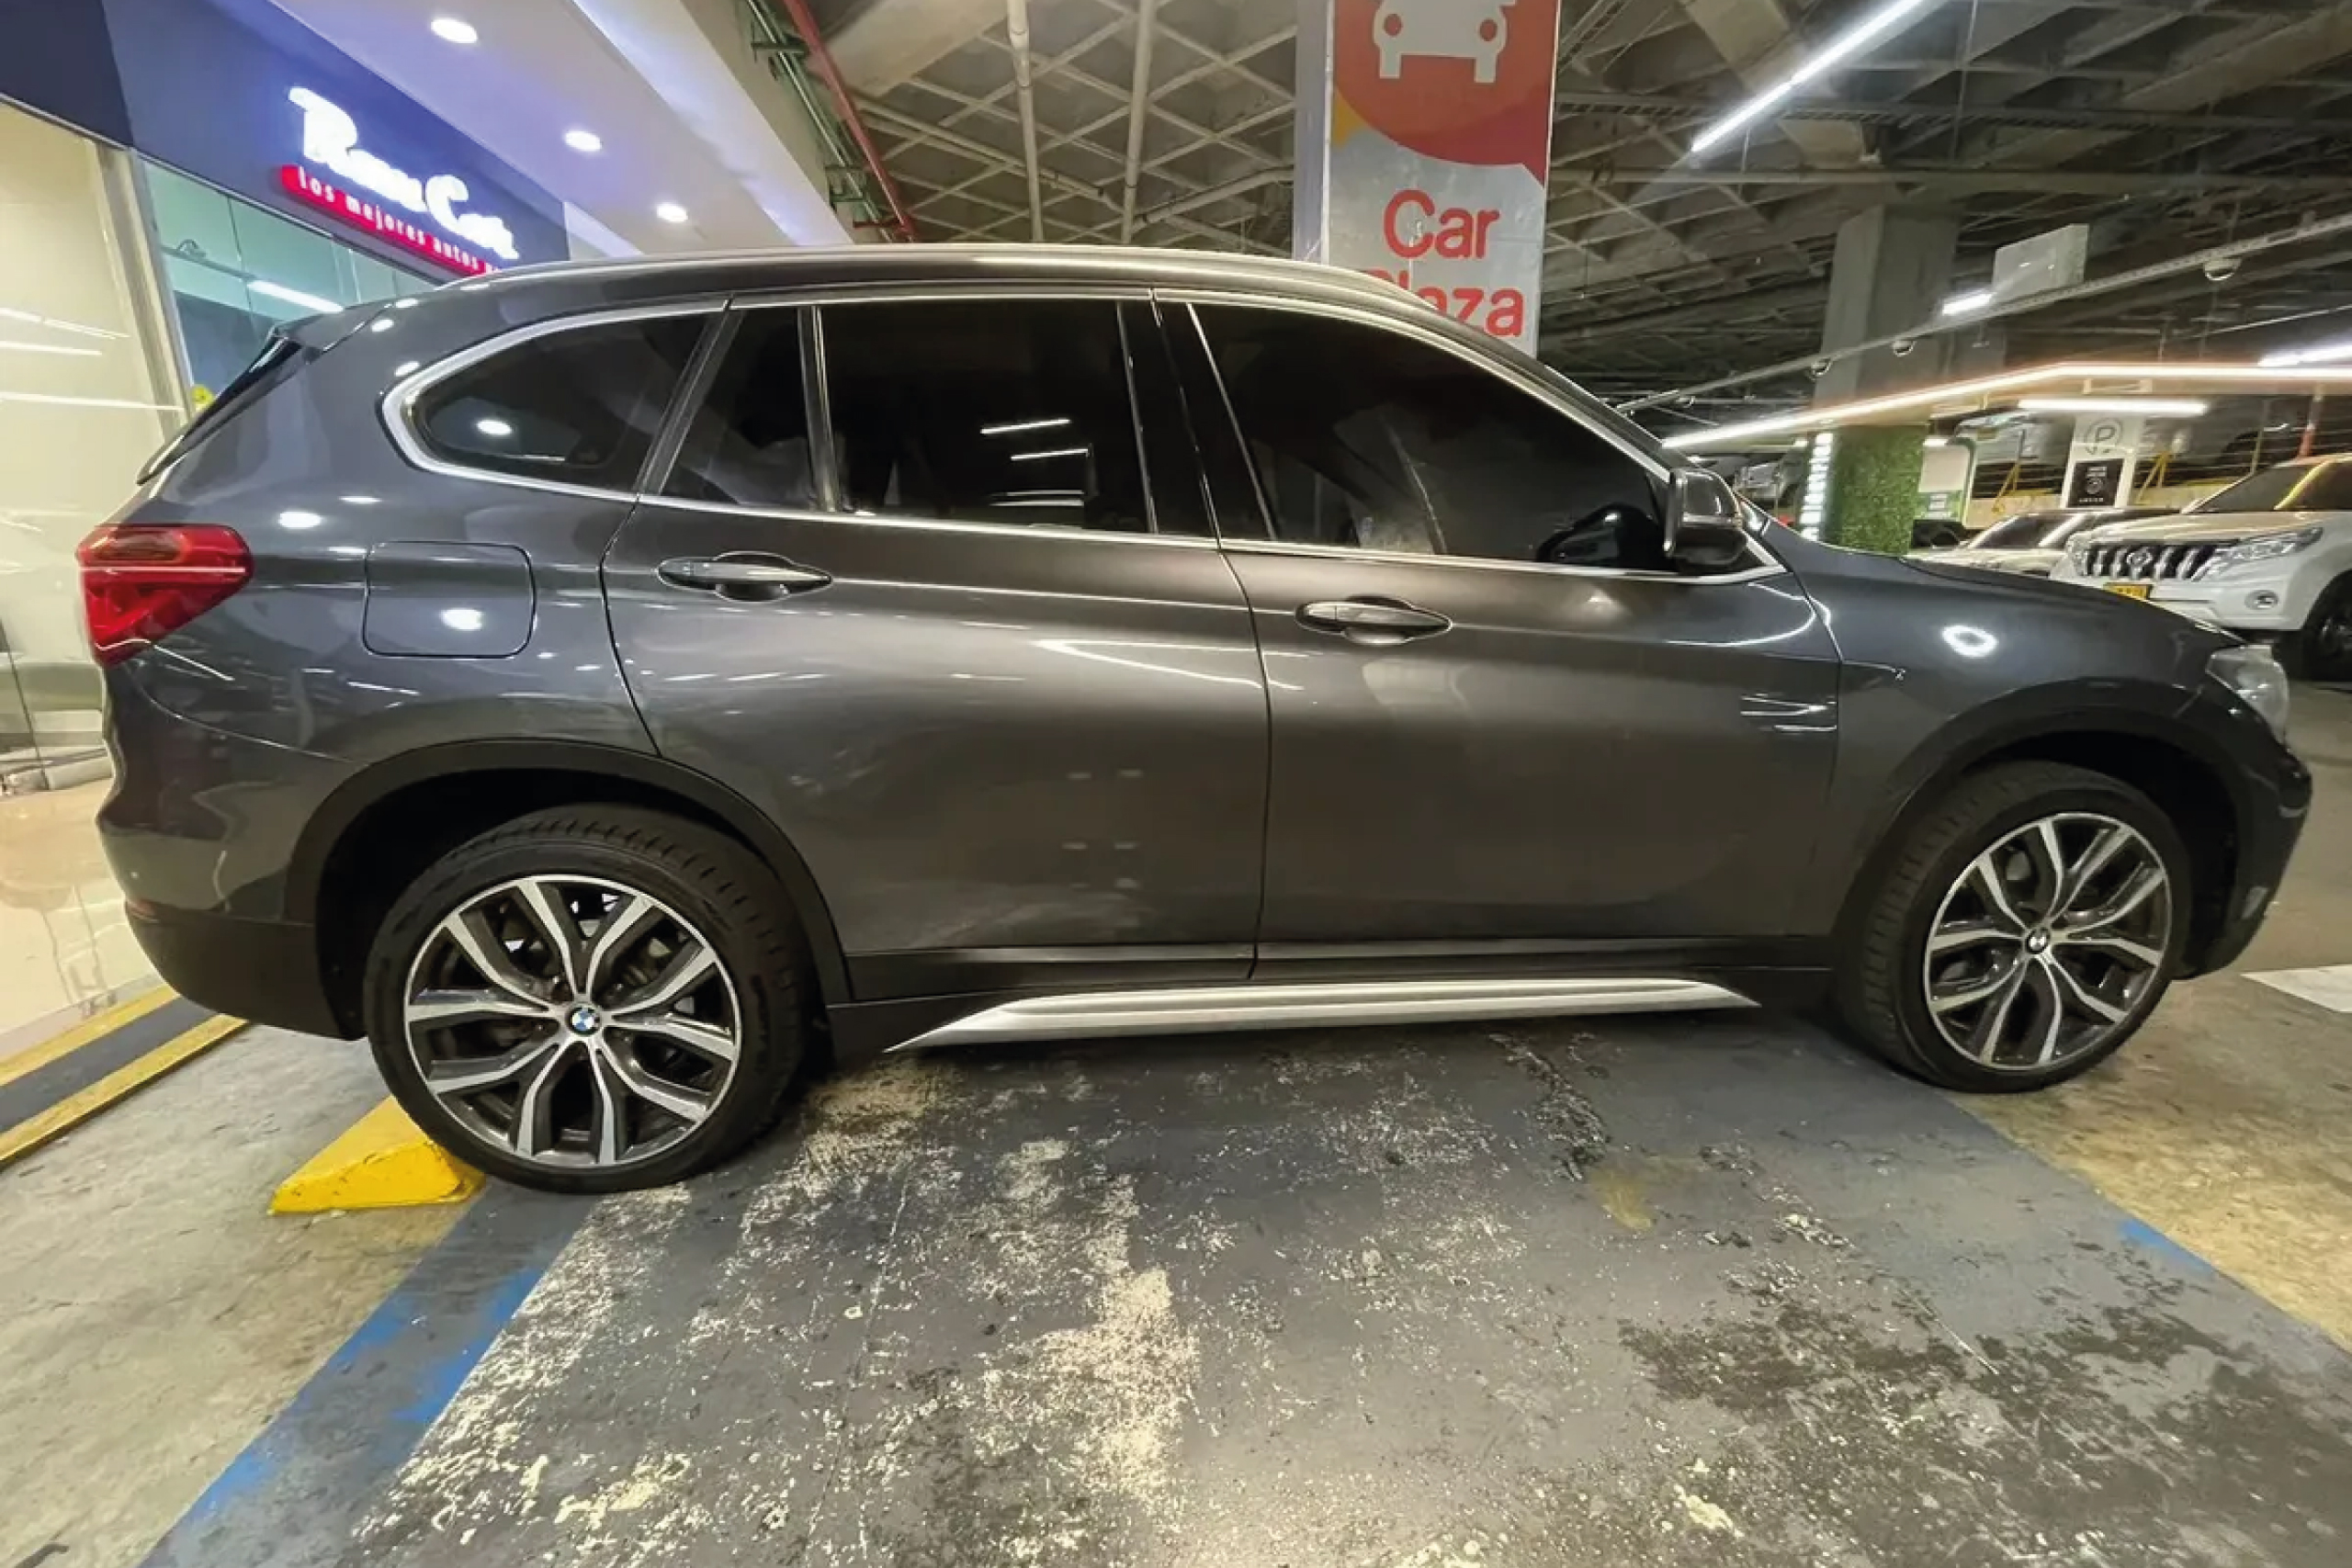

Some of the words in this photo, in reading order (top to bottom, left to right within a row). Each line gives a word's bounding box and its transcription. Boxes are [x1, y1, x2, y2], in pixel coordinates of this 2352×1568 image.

[298, 166, 334, 202] los
[345, 193, 425, 244] mejores
[433, 237, 480, 270] autos
[1383, 188, 1500, 259] Car
